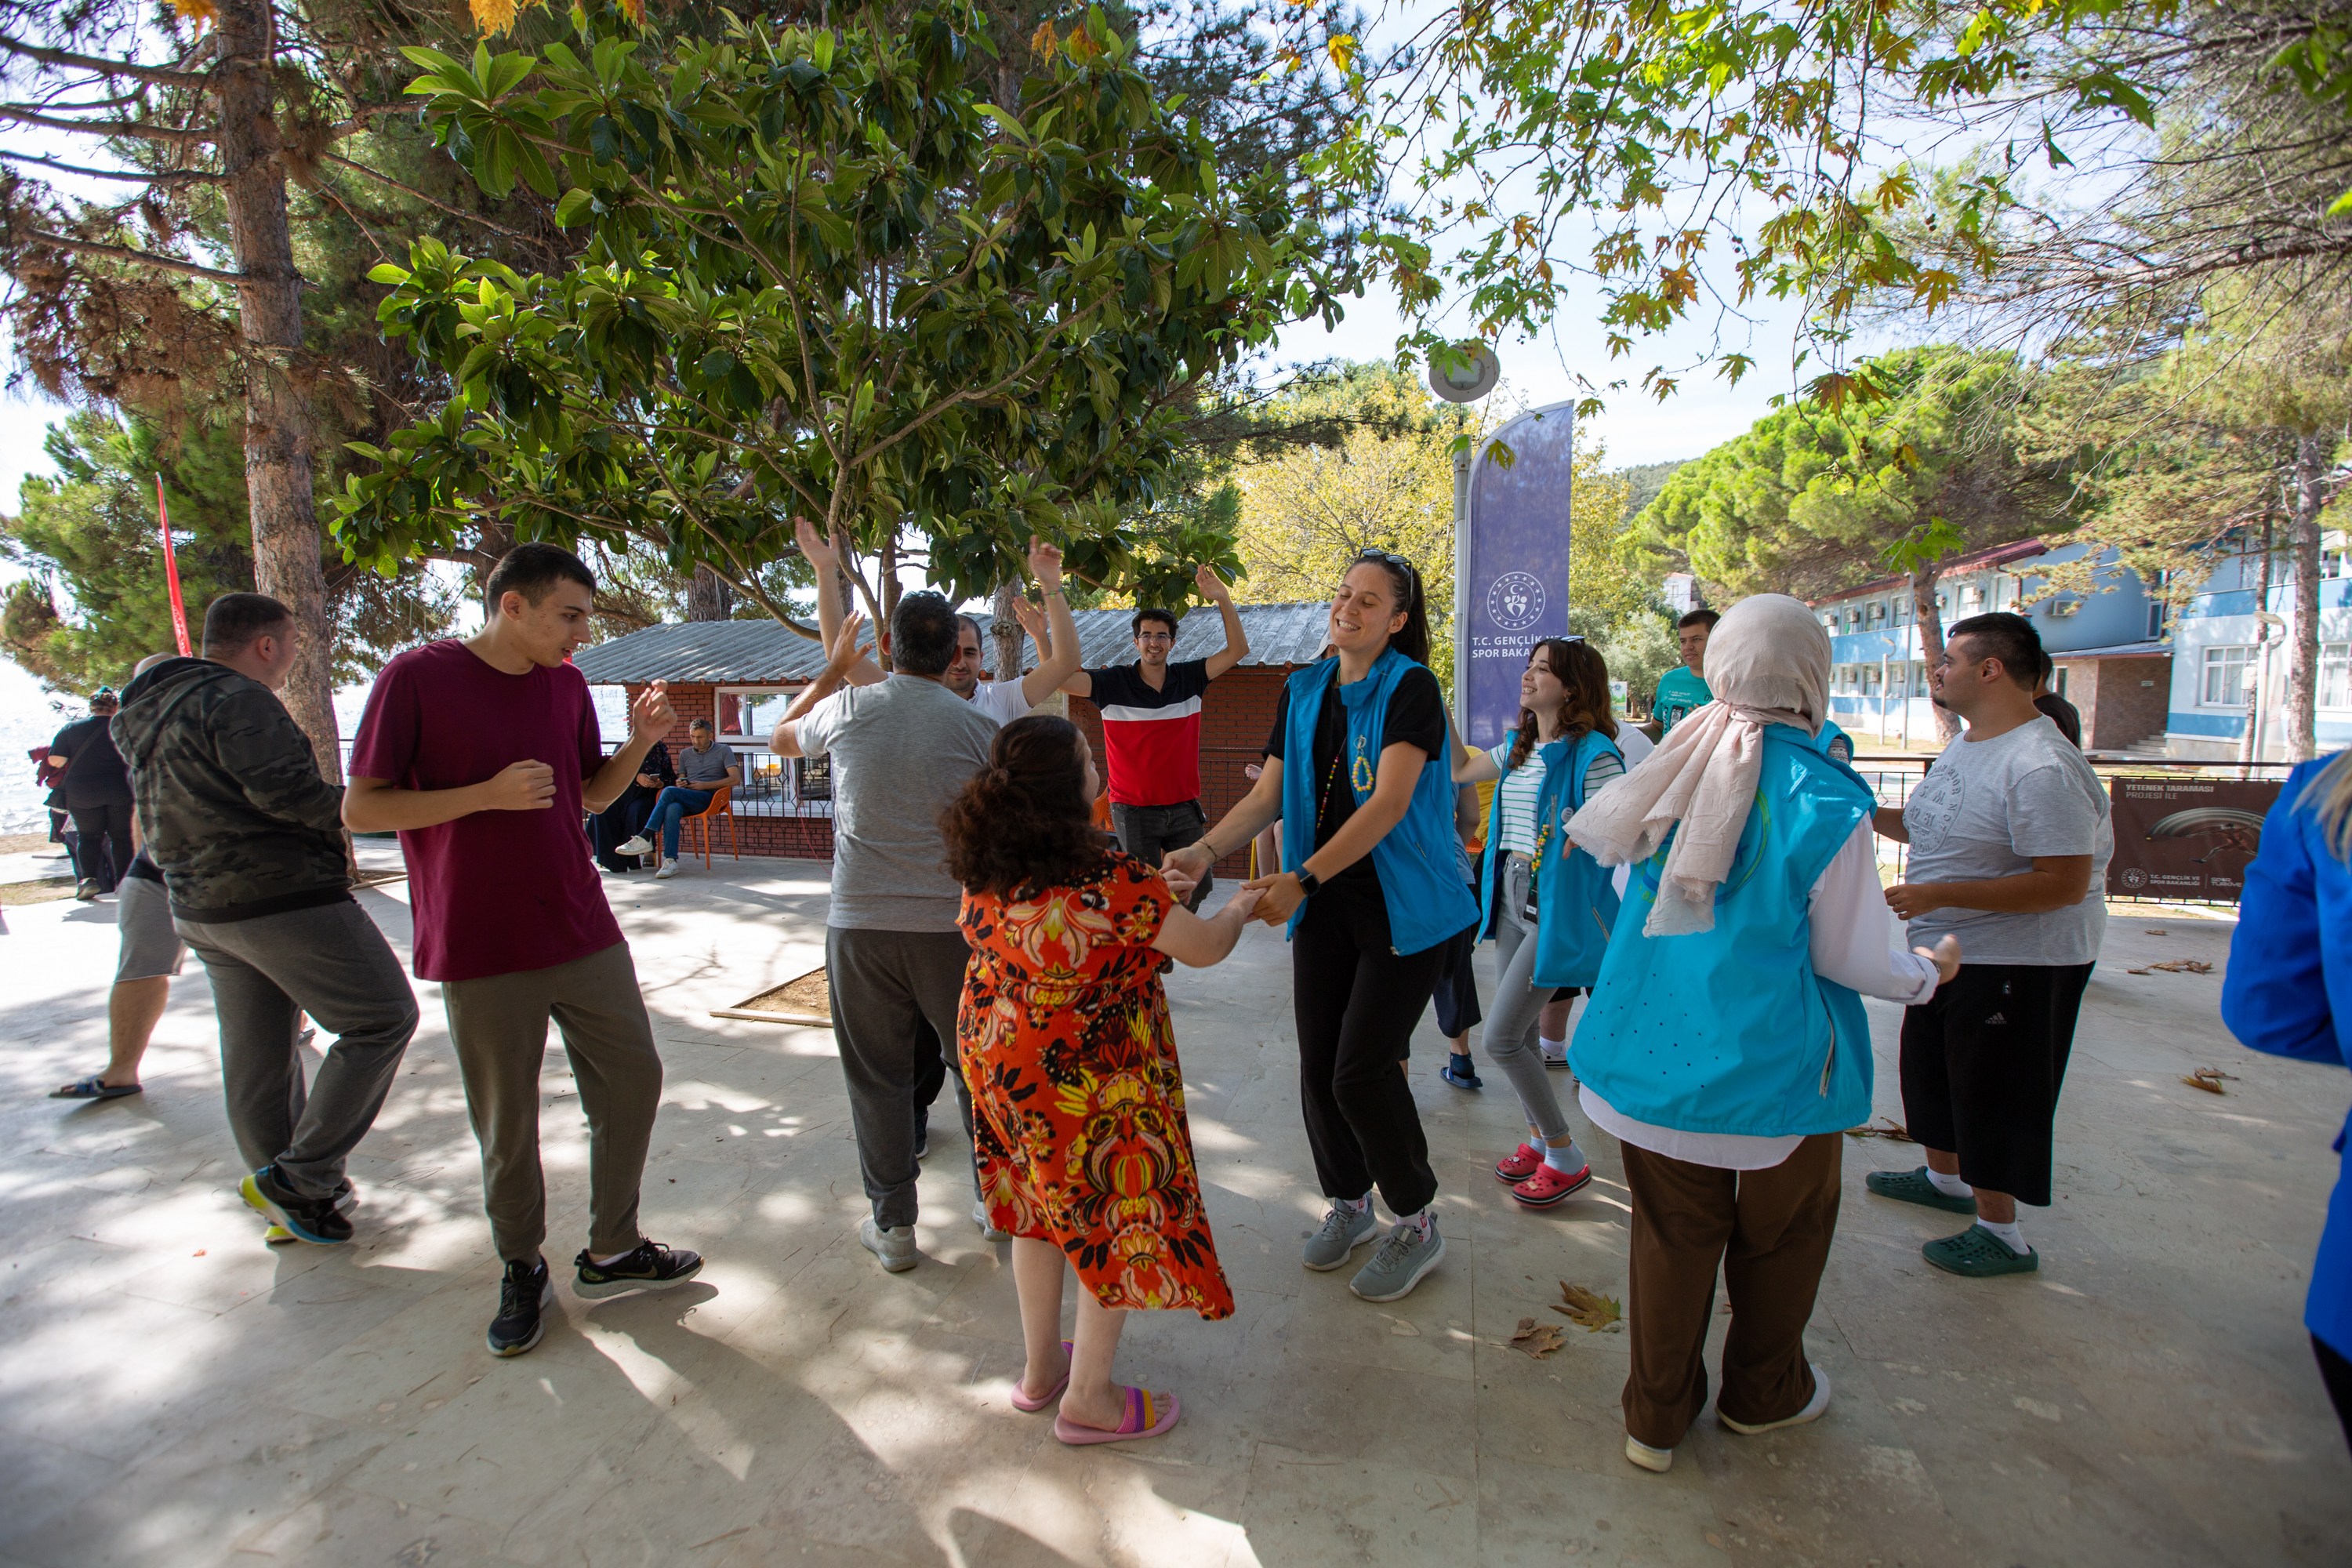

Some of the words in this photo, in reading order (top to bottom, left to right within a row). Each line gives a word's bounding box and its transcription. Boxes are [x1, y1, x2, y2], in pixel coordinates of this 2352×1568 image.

[1472, 637, 1491, 646] T.C.
[1494, 633, 1542, 648] GENÇLİK
[1472, 649, 1499, 659] SPOR
[1502, 648, 1533, 658] BAKA
